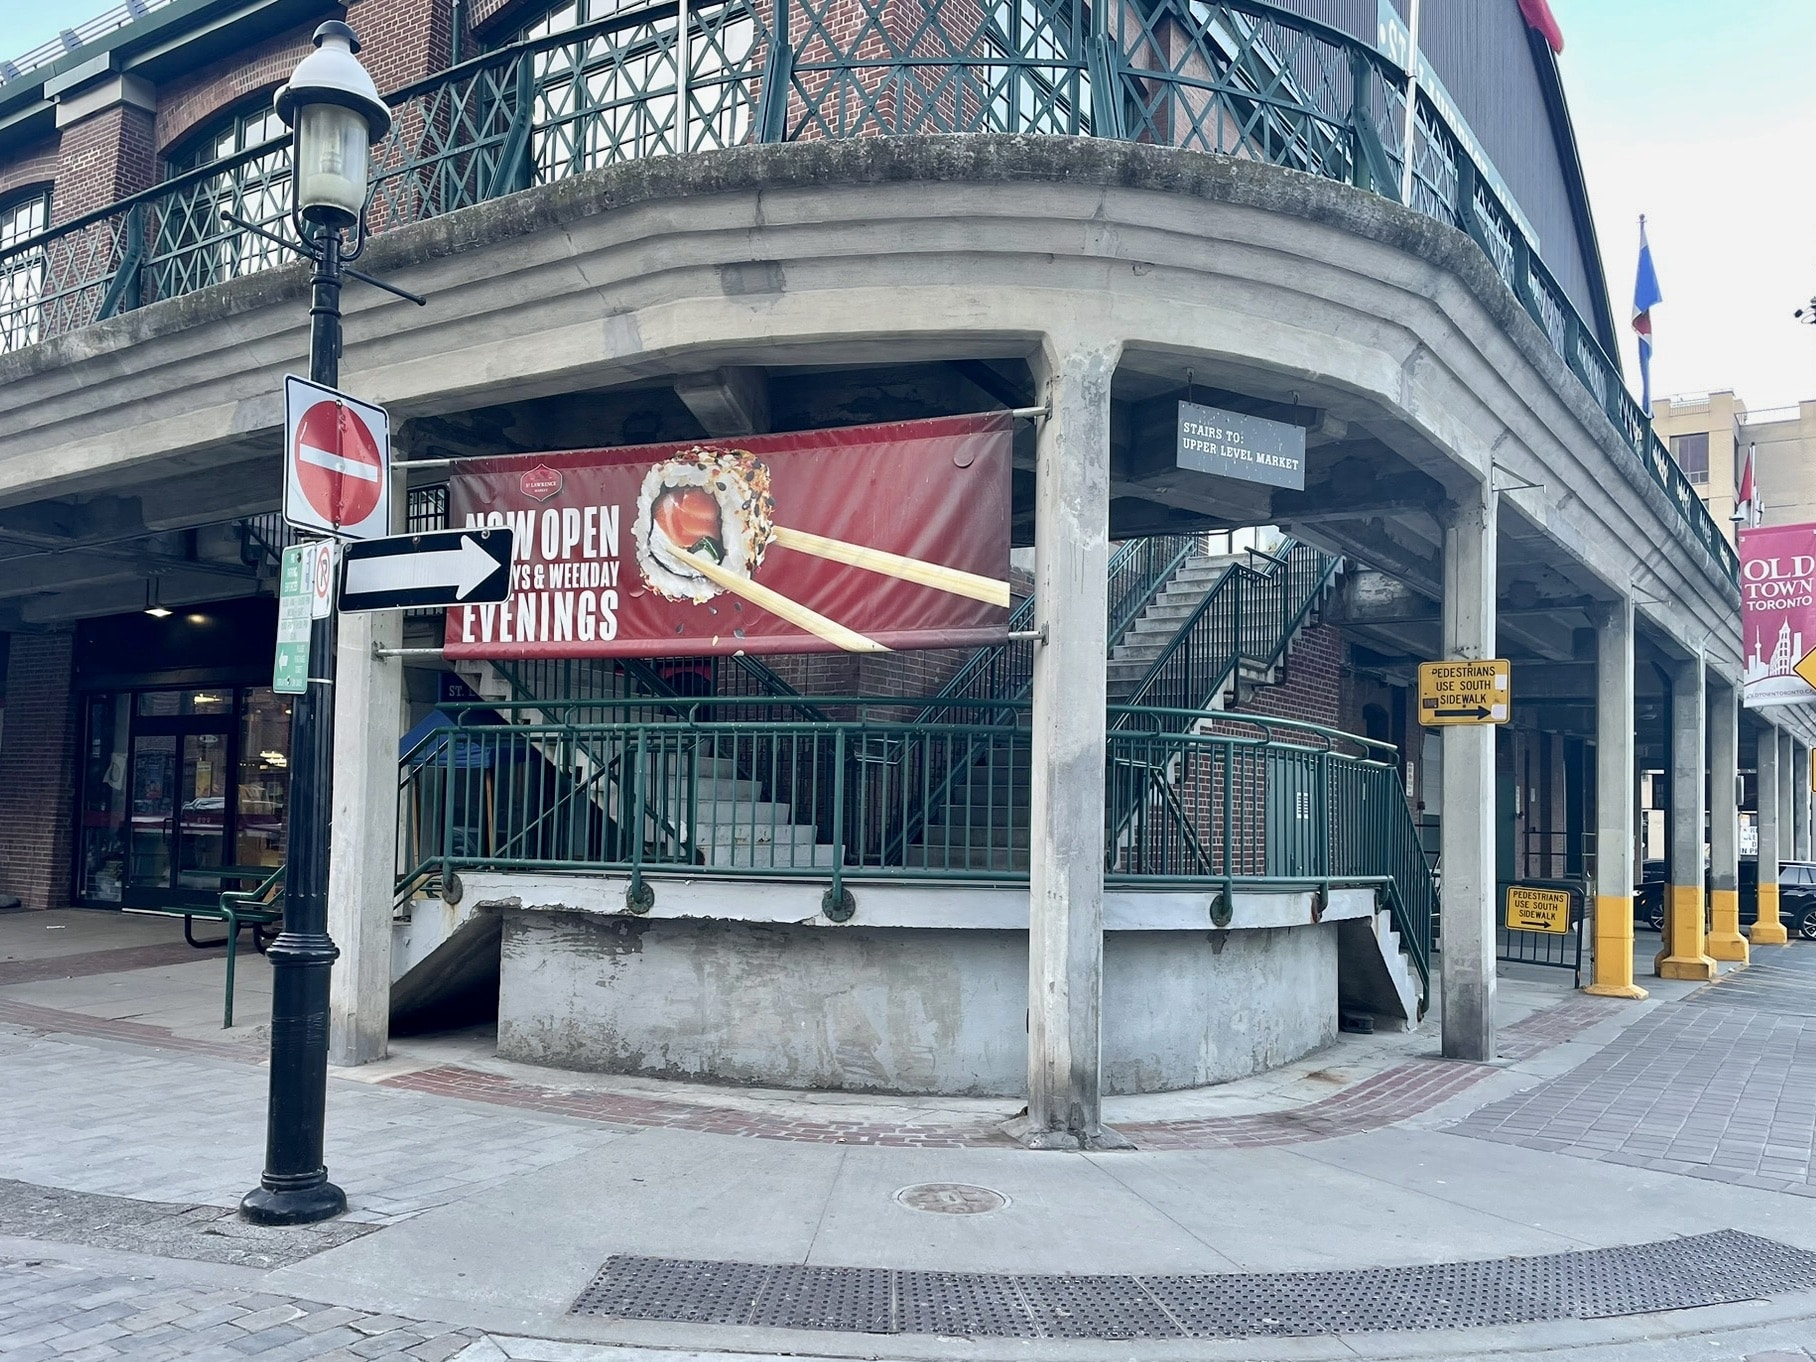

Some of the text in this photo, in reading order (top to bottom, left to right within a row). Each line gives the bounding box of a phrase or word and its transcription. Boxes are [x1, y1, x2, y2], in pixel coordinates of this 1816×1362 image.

[1183, 422, 1244, 444] STAIRS TO:
[1182, 438, 1299, 470] UPPER LEVEL MARKET
[541, 505, 620, 560] OPEN
[533, 564, 545, 589] &
[549, 561, 620, 589] WEEKDAY
[1743, 555, 1815, 581] OLD
[1744, 577, 1815, 599] TOWN
[1746, 595, 1813, 611] TORONTO
[462, 589, 619, 643] EVENINGS
[1432, 666, 1496, 678] PEDESTRIANS
[1436, 680, 1491, 691] USE SOUTH
[1440, 693, 1487, 705] SIDEWALK
[1513, 890, 1565, 903] PEDESTRIANS
[1514, 900, 1558, 911] USE SOUTH
[1519, 910, 1556, 920] SIDEWALK
